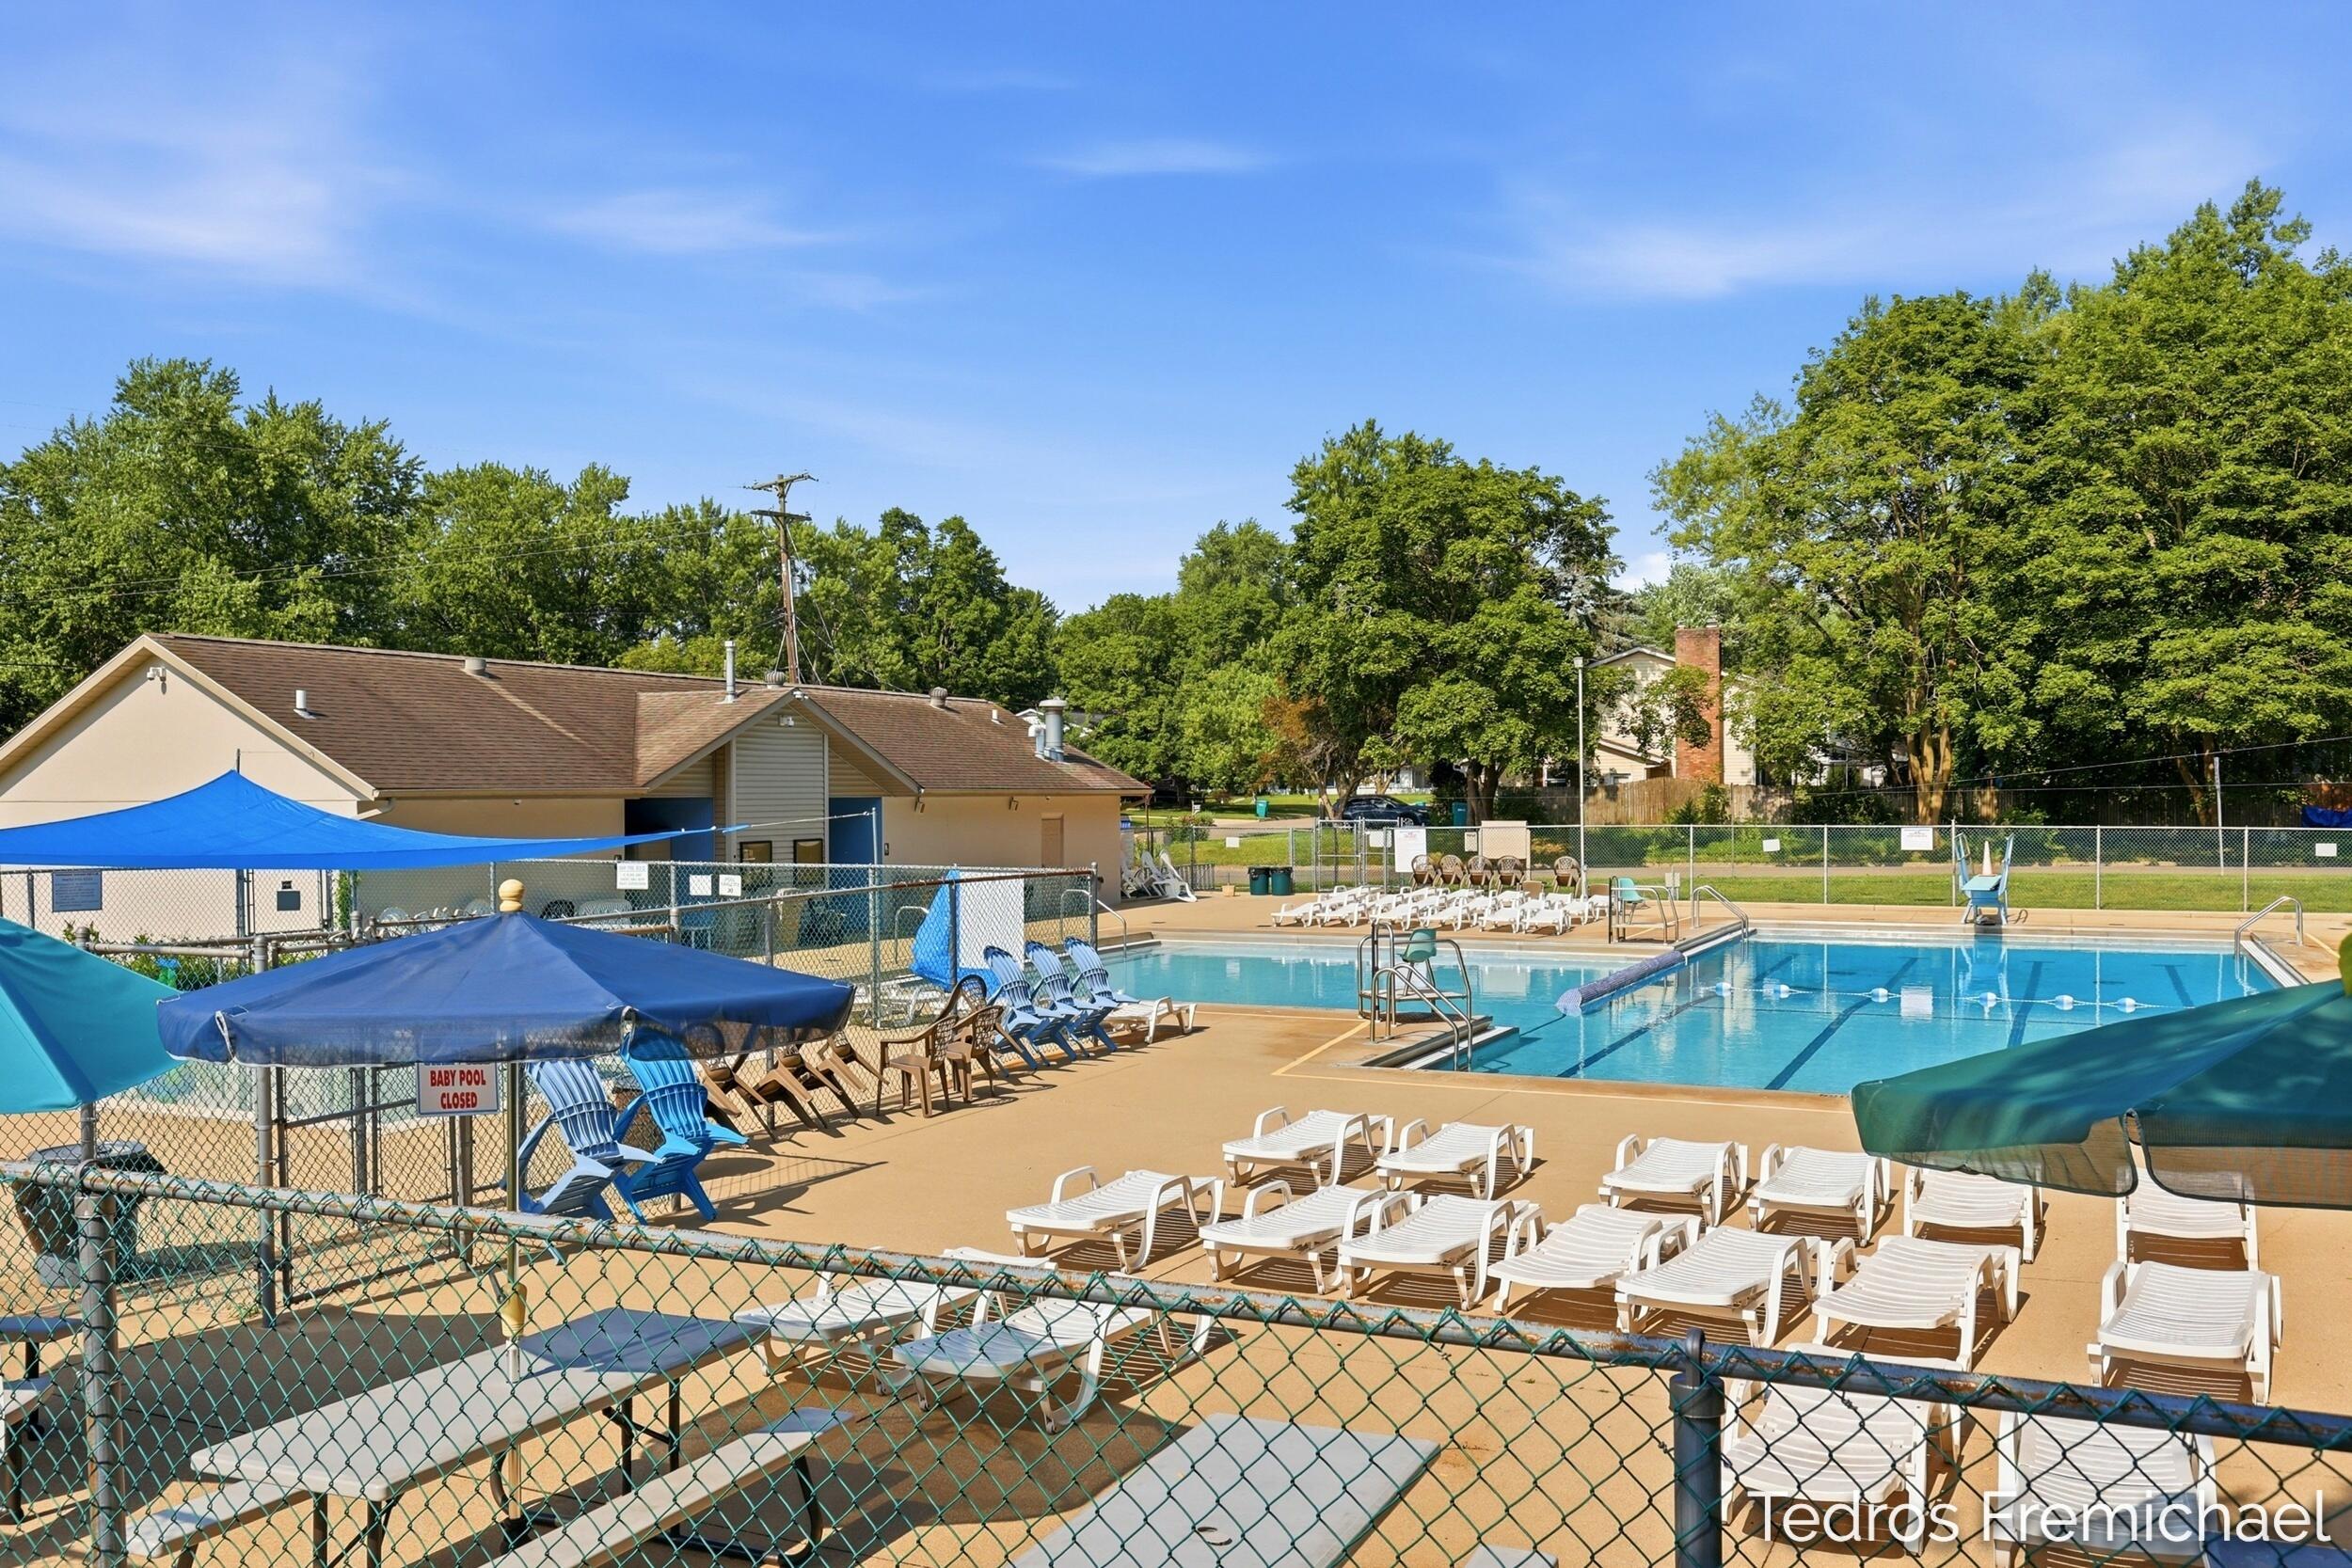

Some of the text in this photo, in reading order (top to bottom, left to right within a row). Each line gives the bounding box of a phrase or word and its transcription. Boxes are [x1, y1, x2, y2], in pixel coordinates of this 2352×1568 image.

[430, 1069, 486, 1086] BABY POOL
[440, 1092, 478, 1109] CLOSED
